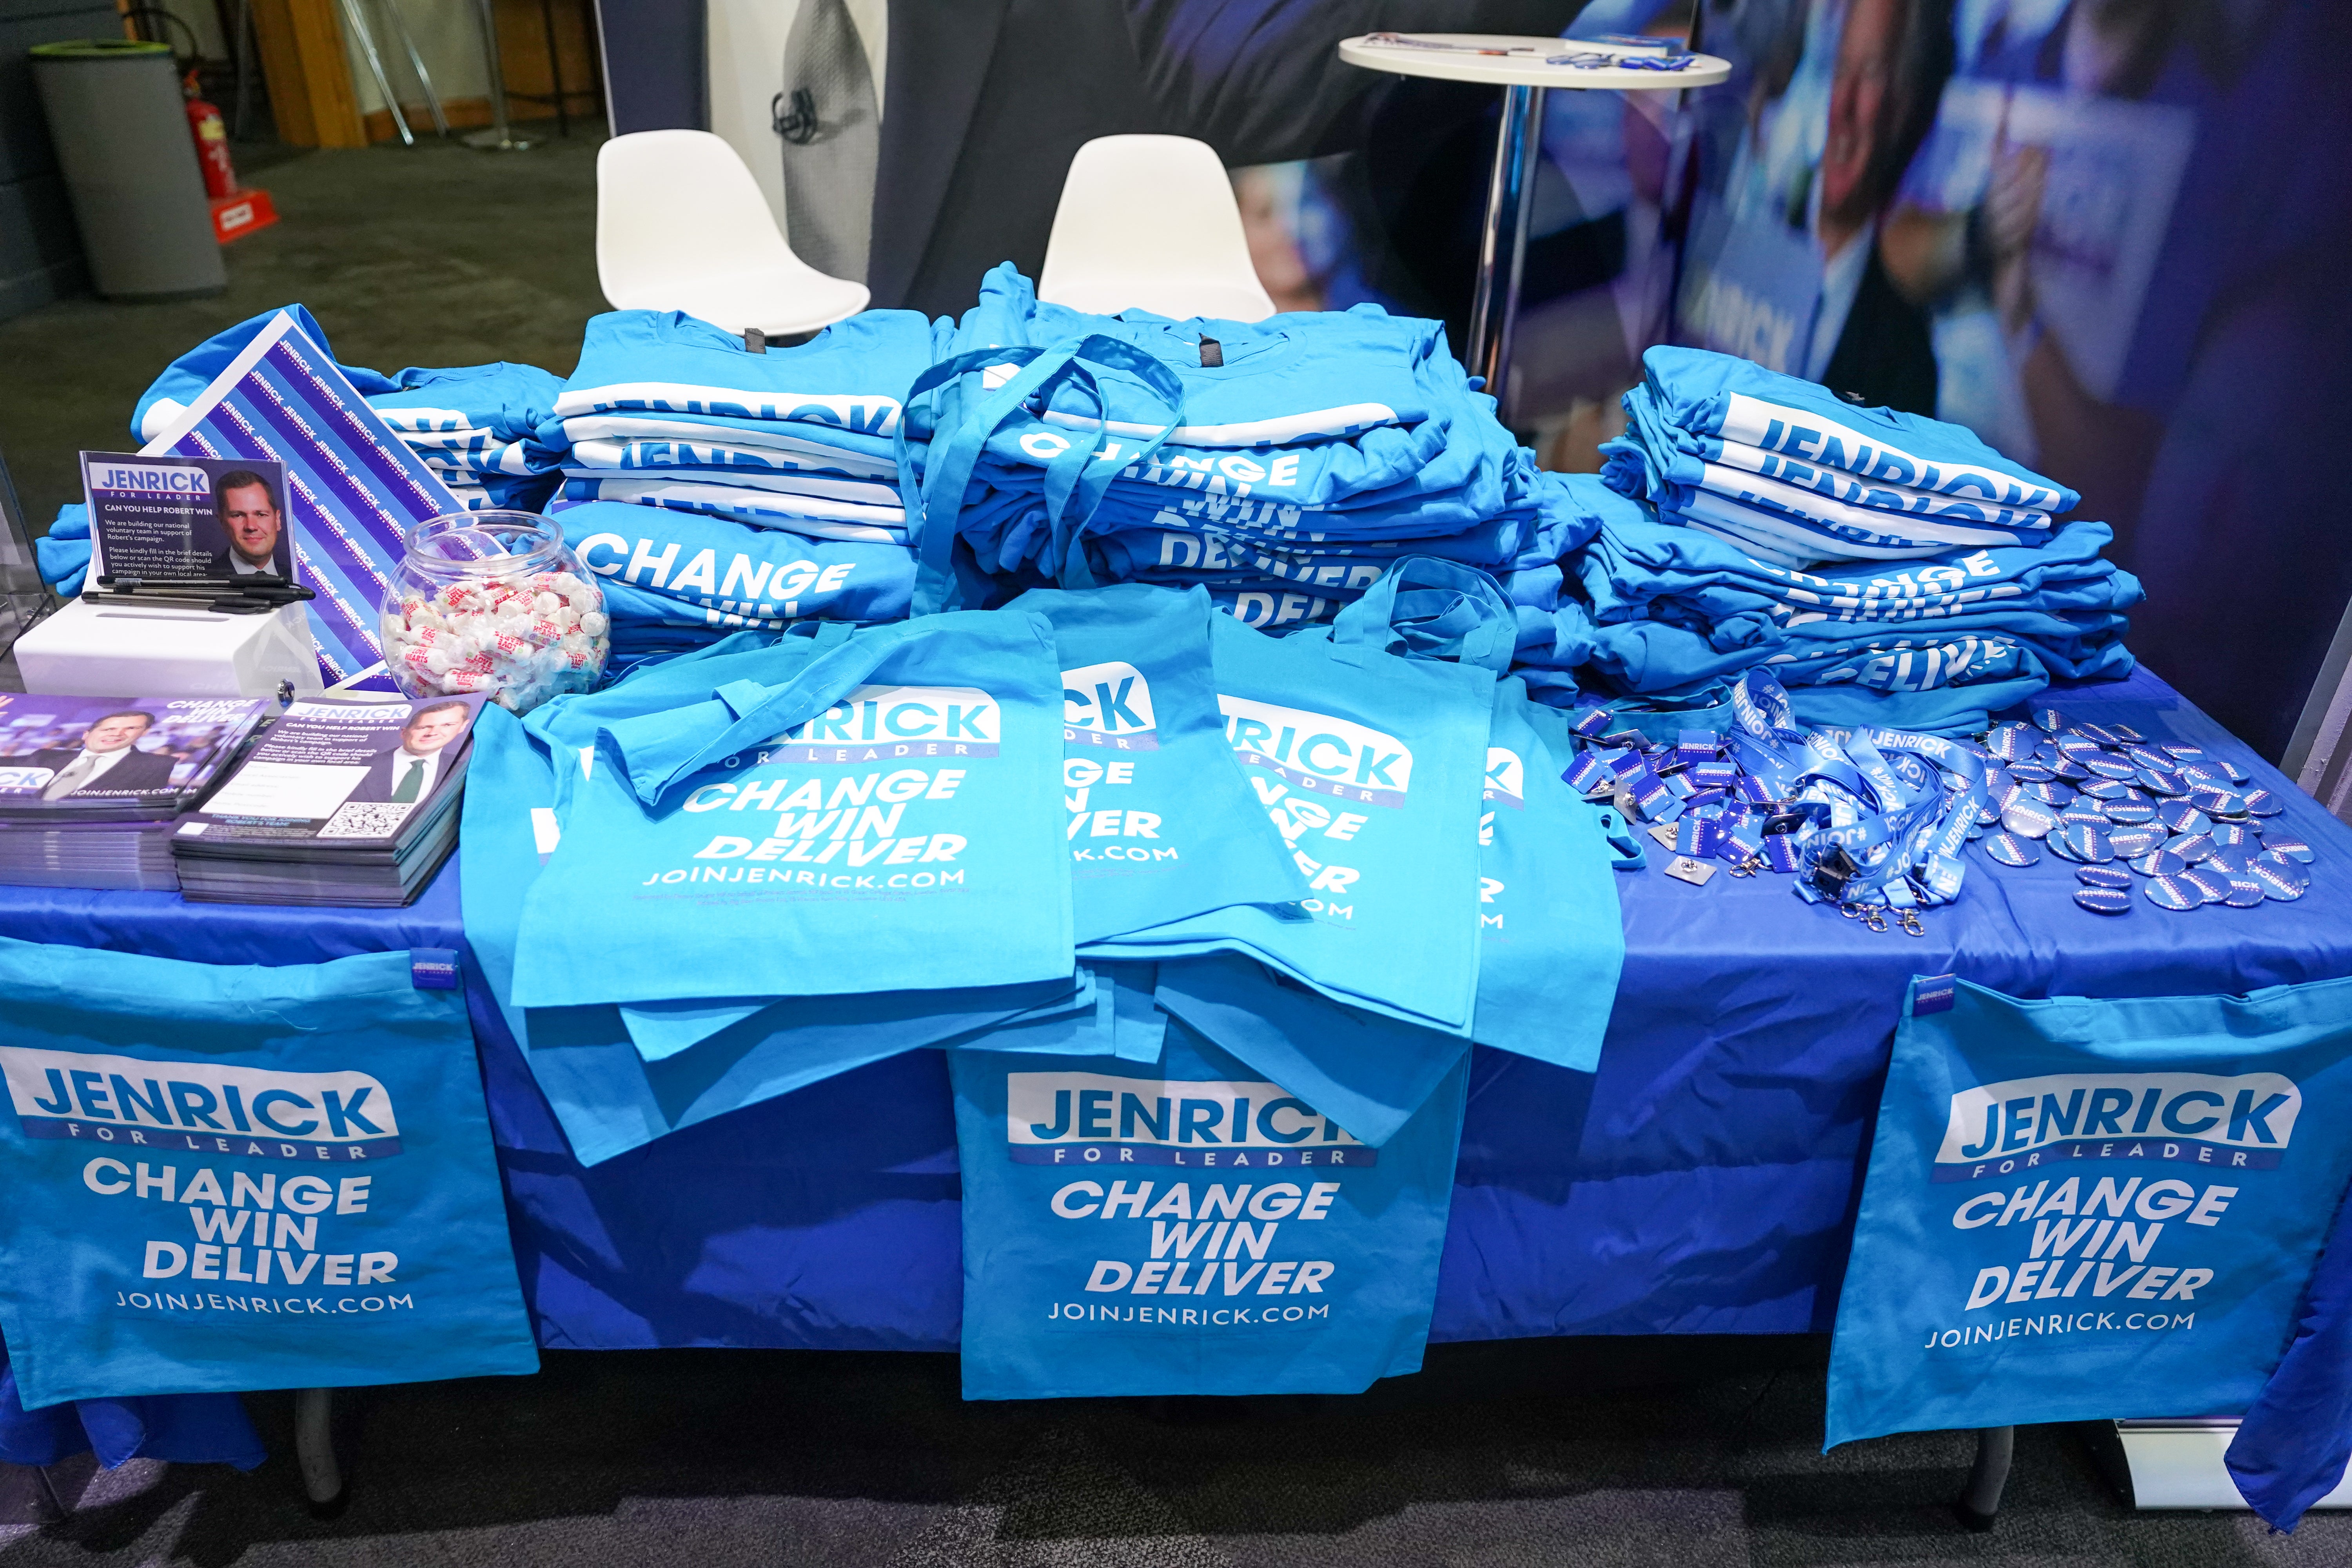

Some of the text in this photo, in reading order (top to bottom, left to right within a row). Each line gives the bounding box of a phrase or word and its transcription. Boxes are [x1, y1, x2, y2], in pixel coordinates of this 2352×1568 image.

[279, 340, 312, 374] JENRICK
[251, 370, 284, 404] JENRICK
[312, 376, 345, 408] JENRICK
[222, 401, 255, 434] JENRICK
[284, 406, 317, 439] JENRICK
[345, 410, 378, 444] JENRICK
[316, 440, 349, 474] JENRICK
[377, 445, 410, 479] JENRICK
[102, 470, 207, 492] JENRICK
[348, 475, 380, 508] JENRICK
[410, 479, 443, 512] JENRICK
[316, 504, 348, 537] JENRICK
[345, 538, 376, 570] JENRICK
[576, 532, 857, 600] CHANGE
[309, 565, 338, 597] JENRICK
[336, 598, 366, 628] JENRICK
[405, 653, 428, 663] HEARTS
[474, 655, 493, 666] LOVE
[498, 640, 516, 651] LOVE
[162, 713, 246, 722] DELIVER
[167, 699, 259, 708] CHANGE
[298, 707, 408, 718] JENRICK
[785, 700, 989, 740] RICK
[724, 744, 968, 768] OR LEADER
[1221, 714, 1403, 787] RICK
[2091, 761, 2134, 772] JENRICK
[2134, 749, 2175, 768] JENRICK
[1249, 753, 1373, 802] EADER
[1574, 758, 1598, 786] JENRICK
[682, 769, 967, 814] CHANGE
[1639, 786, 1668, 808] JENRICK
[775, 802, 907, 840] WIN
[1250, 777, 1368, 841] NGE
[2010, 805, 2054, 824] JENRICK
[2180, 809, 2200, 831] JENRICK
[693, 833, 967, 867] DELIVER
[1690, 819, 1700, 855] JENRICK
[1783, 836, 1798, 869] JENRICK
[1998, 835, 2024, 863] JENRICK
[2084, 825, 2093, 858] JENRICK
[642, 866, 965, 889] JOINJENRICK.COM
[2083, 866, 2129, 877] JENRICK
[2253, 866, 2301, 896] JENRICK
[2078, 889, 2127, 898] JENRICK
[2157, 876, 2186, 906] JENRICK
[412, 962, 453, 971] JENRICK
[1916, 987, 1953, 1001] JENRICK
[33, 1068, 386, 1138] JENRICK
[1961, 1088, 2292, 1160] JENRICK
[69, 1123, 367, 1160] FOR LEADER
[1054, 1147, 1344, 1166] FOR LEADER
[1973, 1143, 2247, 1178] FOR LEADER
[83, 1157, 371, 1215] CHANGE
[1051, 1180, 1341, 1221] CHANGE
[1952, 1176, 2239, 1230] CHANGE
[189, 1206, 318, 1251] WIN
[1150, 1221, 1279, 1260] WIN
[2029, 1219, 2164, 1263] WIN
[143, 1240, 399, 1286] DELIVER
[1084, 1261, 1334, 1296] DELIVER
[116, 1291, 414, 1315] JOINJENRICK.COM
[1964, 1261, 2214, 1312] DELIVER
[1048, 1302, 1329, 1326] JOINJENRICK.COM
[1925, 1312, 2196, 1349] JOINJENRICK.COM
